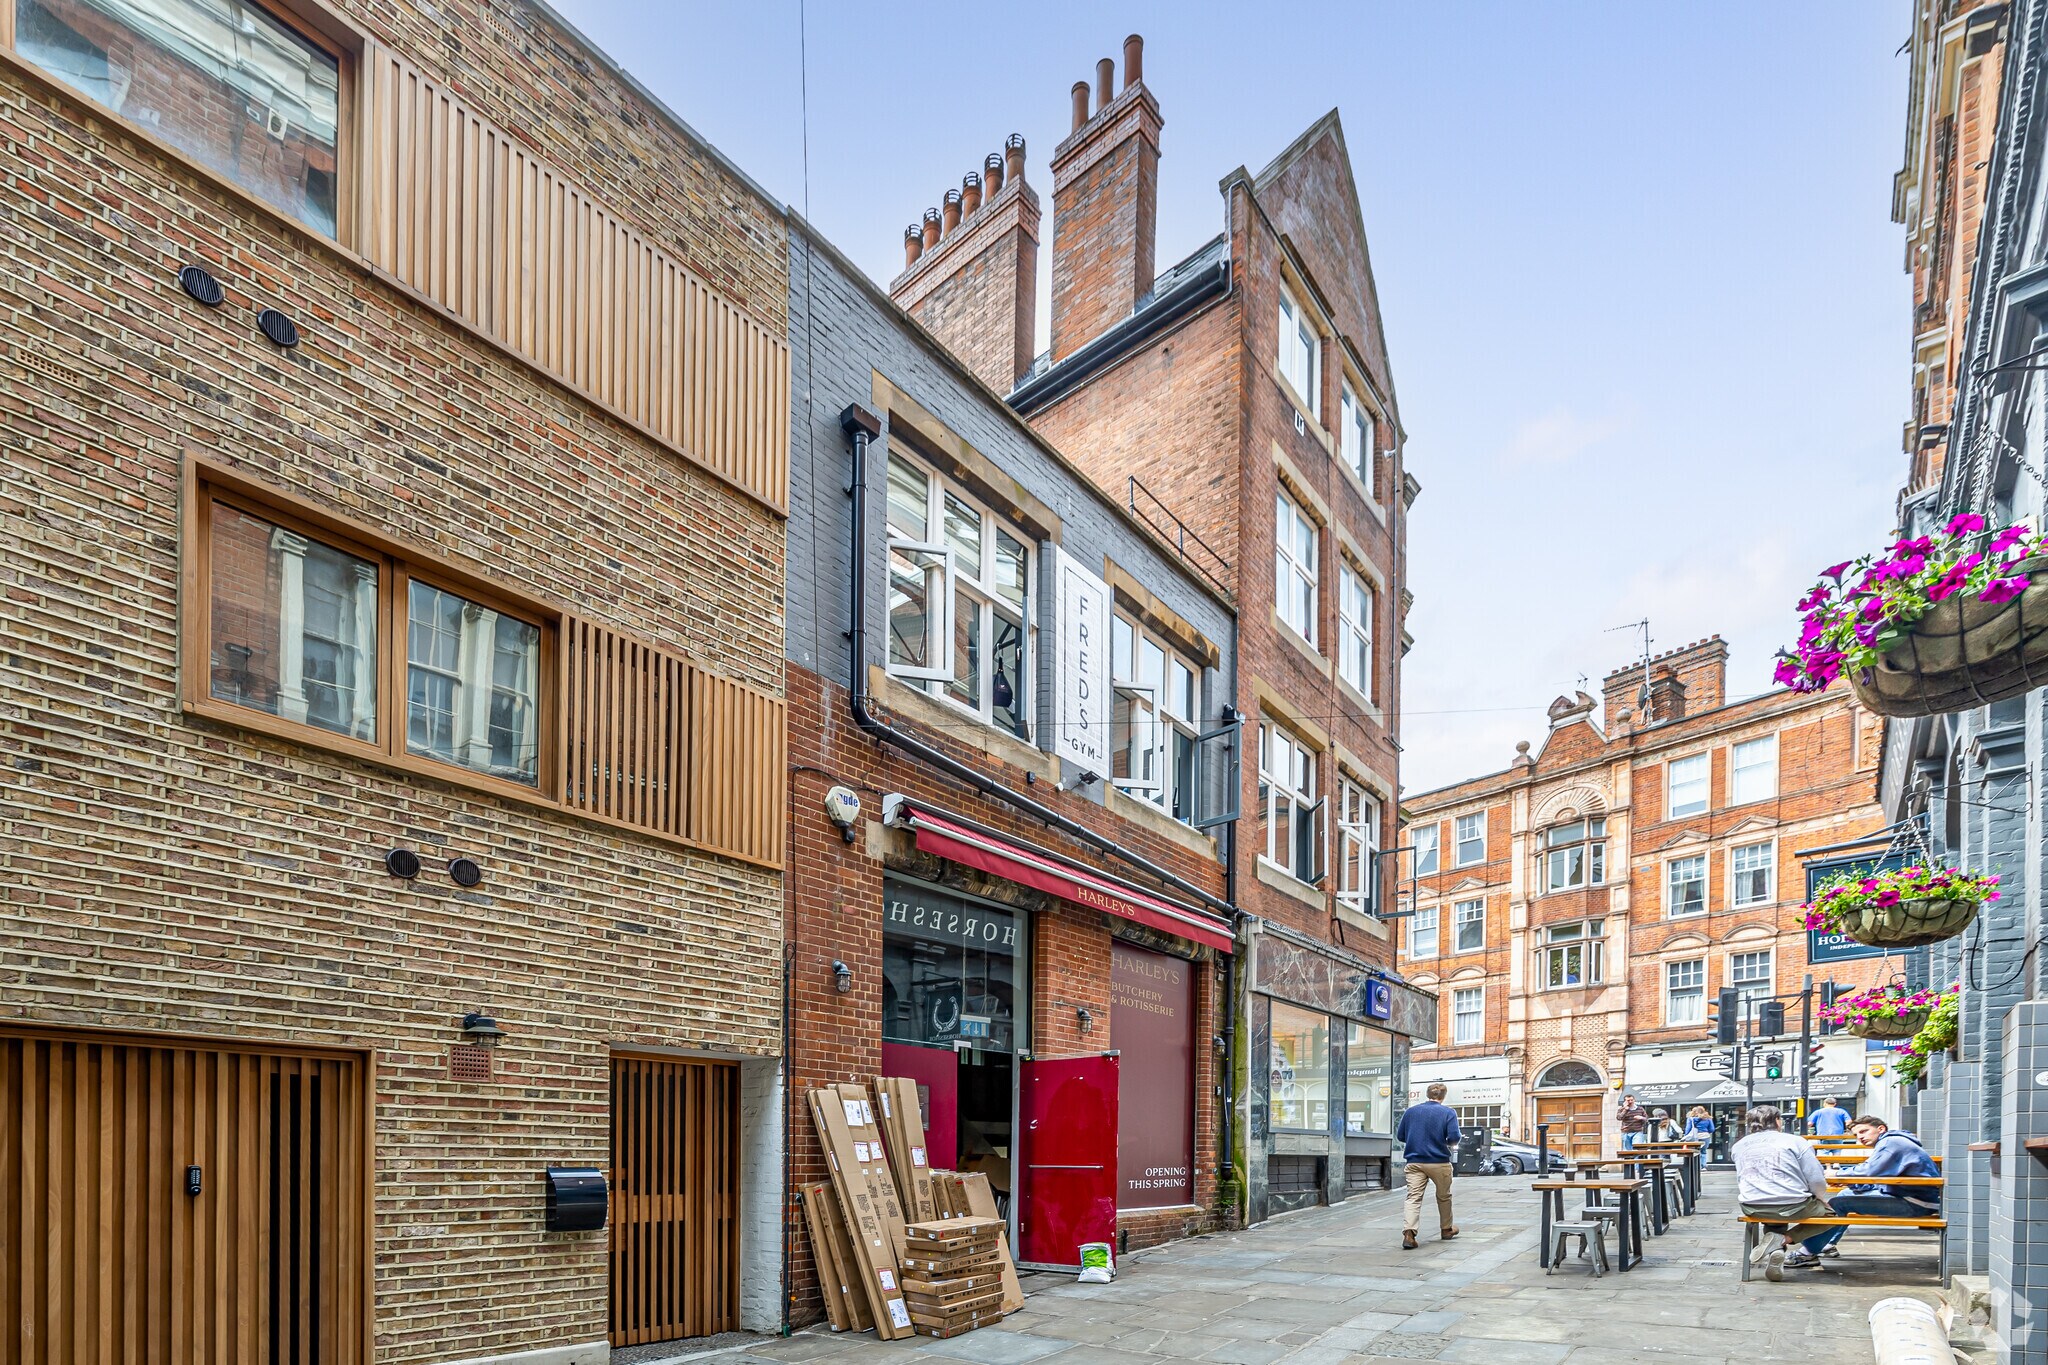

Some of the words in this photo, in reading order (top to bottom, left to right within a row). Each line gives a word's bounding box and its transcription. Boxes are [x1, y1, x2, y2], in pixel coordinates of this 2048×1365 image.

[1079, 594, 1091, 731] FRED'S
[1071, 738, 1096, 760] GYM
[1077, 887, 1136, 917] HARLEY'S
[1111, 952, 1181, 985] HARLEY'S
[1111, 981, 1164, 1003] BUTCHERY
[1110, 994, 1118, 1004] &
[1119, 995, 1175, 1018] ROTISSERIE
[1145, 1166, 1186, 1177] OPENING
[1128, 1179, 1152, 1189] THIS
[1152, 1178, 1186, 1188] SPRING
